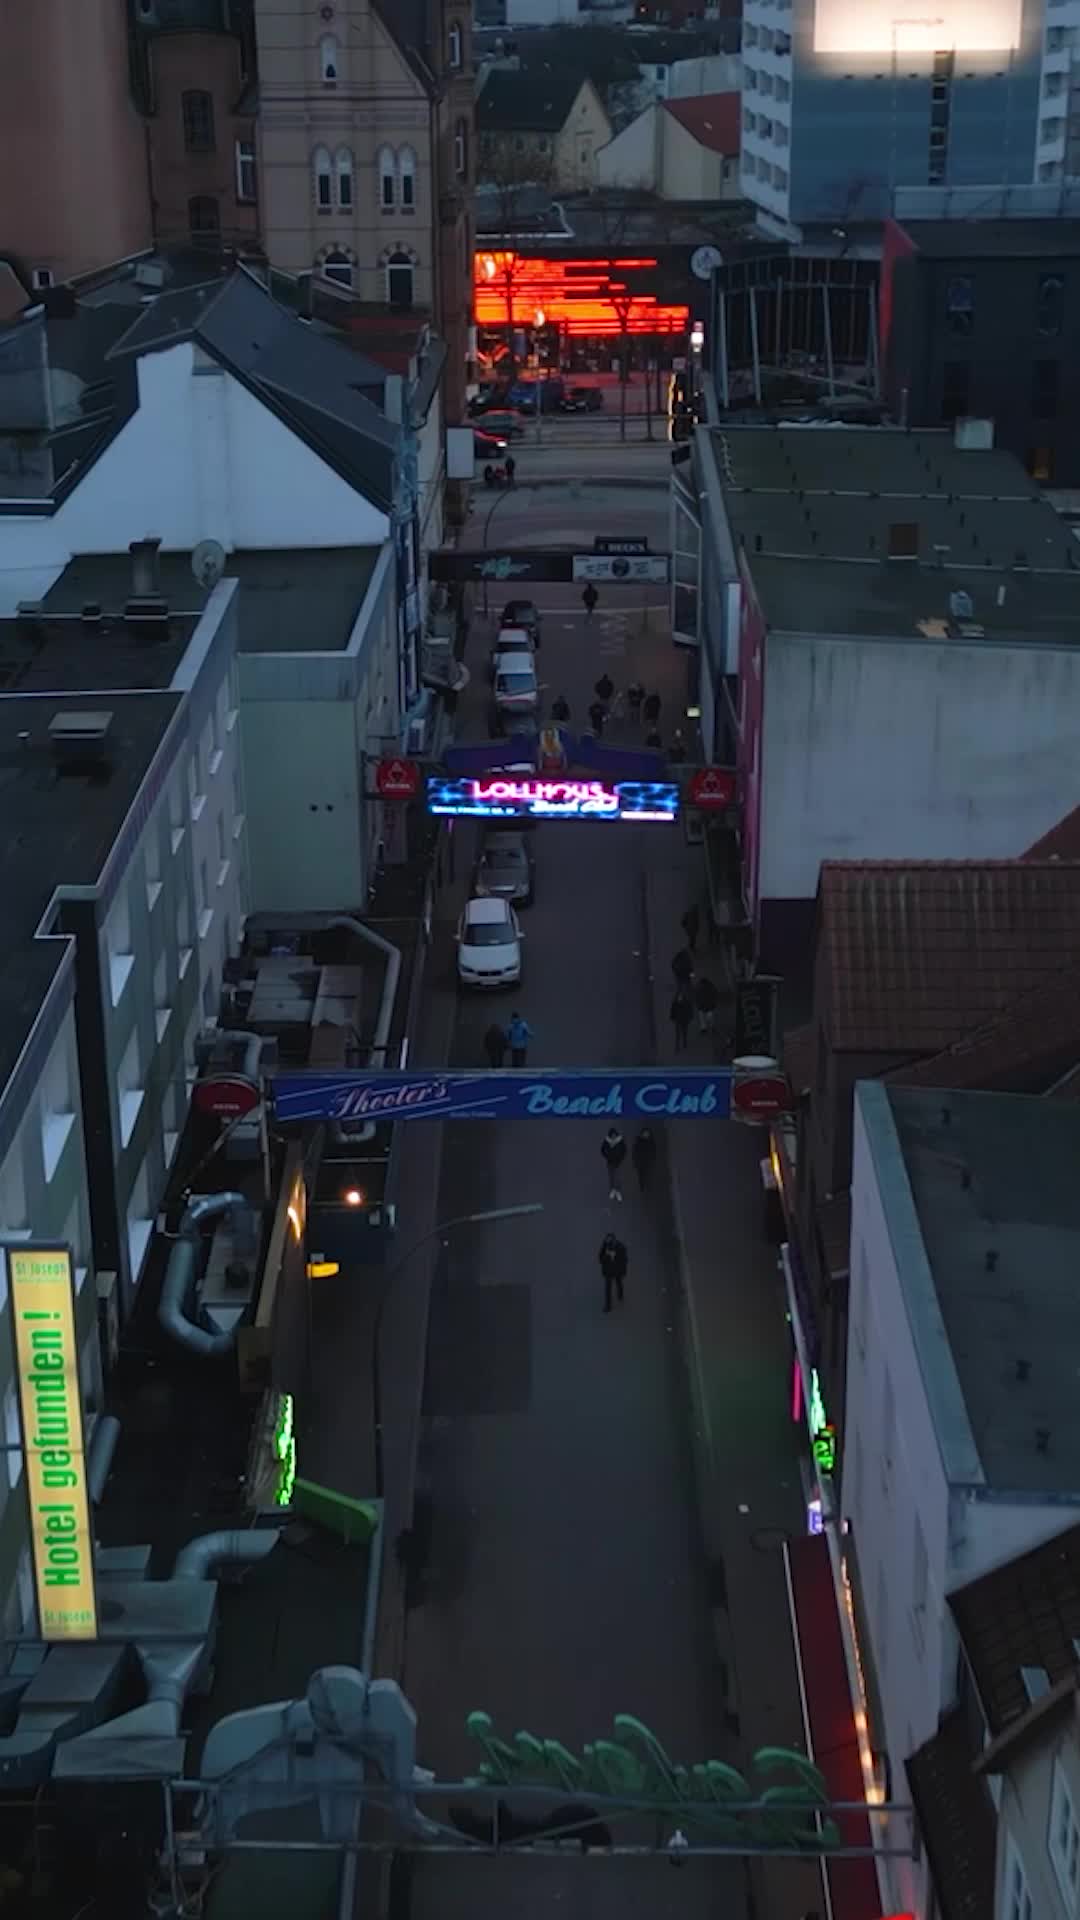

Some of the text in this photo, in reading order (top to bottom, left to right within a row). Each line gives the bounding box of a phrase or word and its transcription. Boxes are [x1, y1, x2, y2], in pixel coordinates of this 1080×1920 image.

[329, 1079, 717, 1117] Shooter's Beach Club
[28, 1330, 77, 1487] gefunden
[40, 1505, 79, 1586] Hotel
